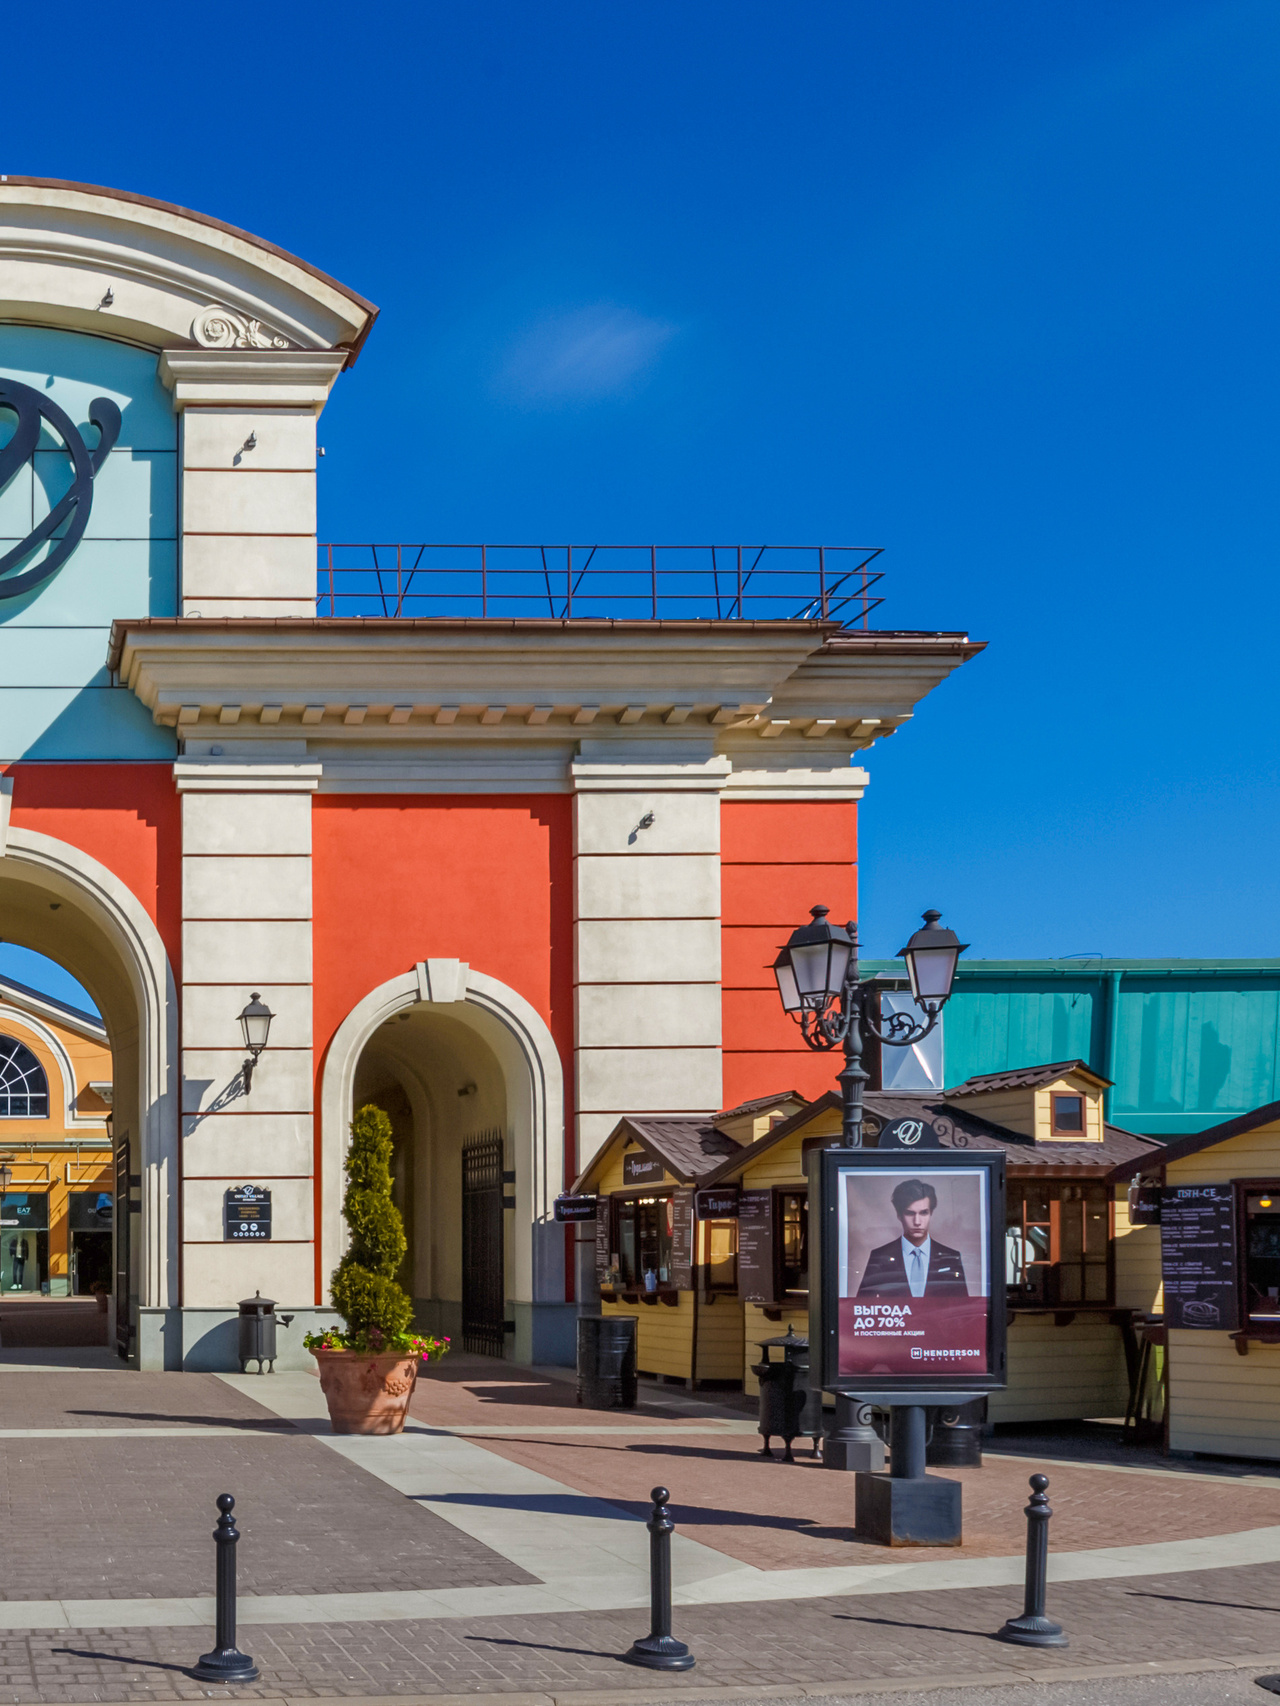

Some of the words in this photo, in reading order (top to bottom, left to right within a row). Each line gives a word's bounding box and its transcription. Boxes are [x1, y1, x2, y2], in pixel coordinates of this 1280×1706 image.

[708, 1198, 732, 1212] Гирос
[853, 1305, 912, 1317] ВЫГОДА
[853, 1317, 875, 1329] ДО
[877, 1317, 905, 1328] 70%
[923, 1349, 980, 1357] HENDERSON
